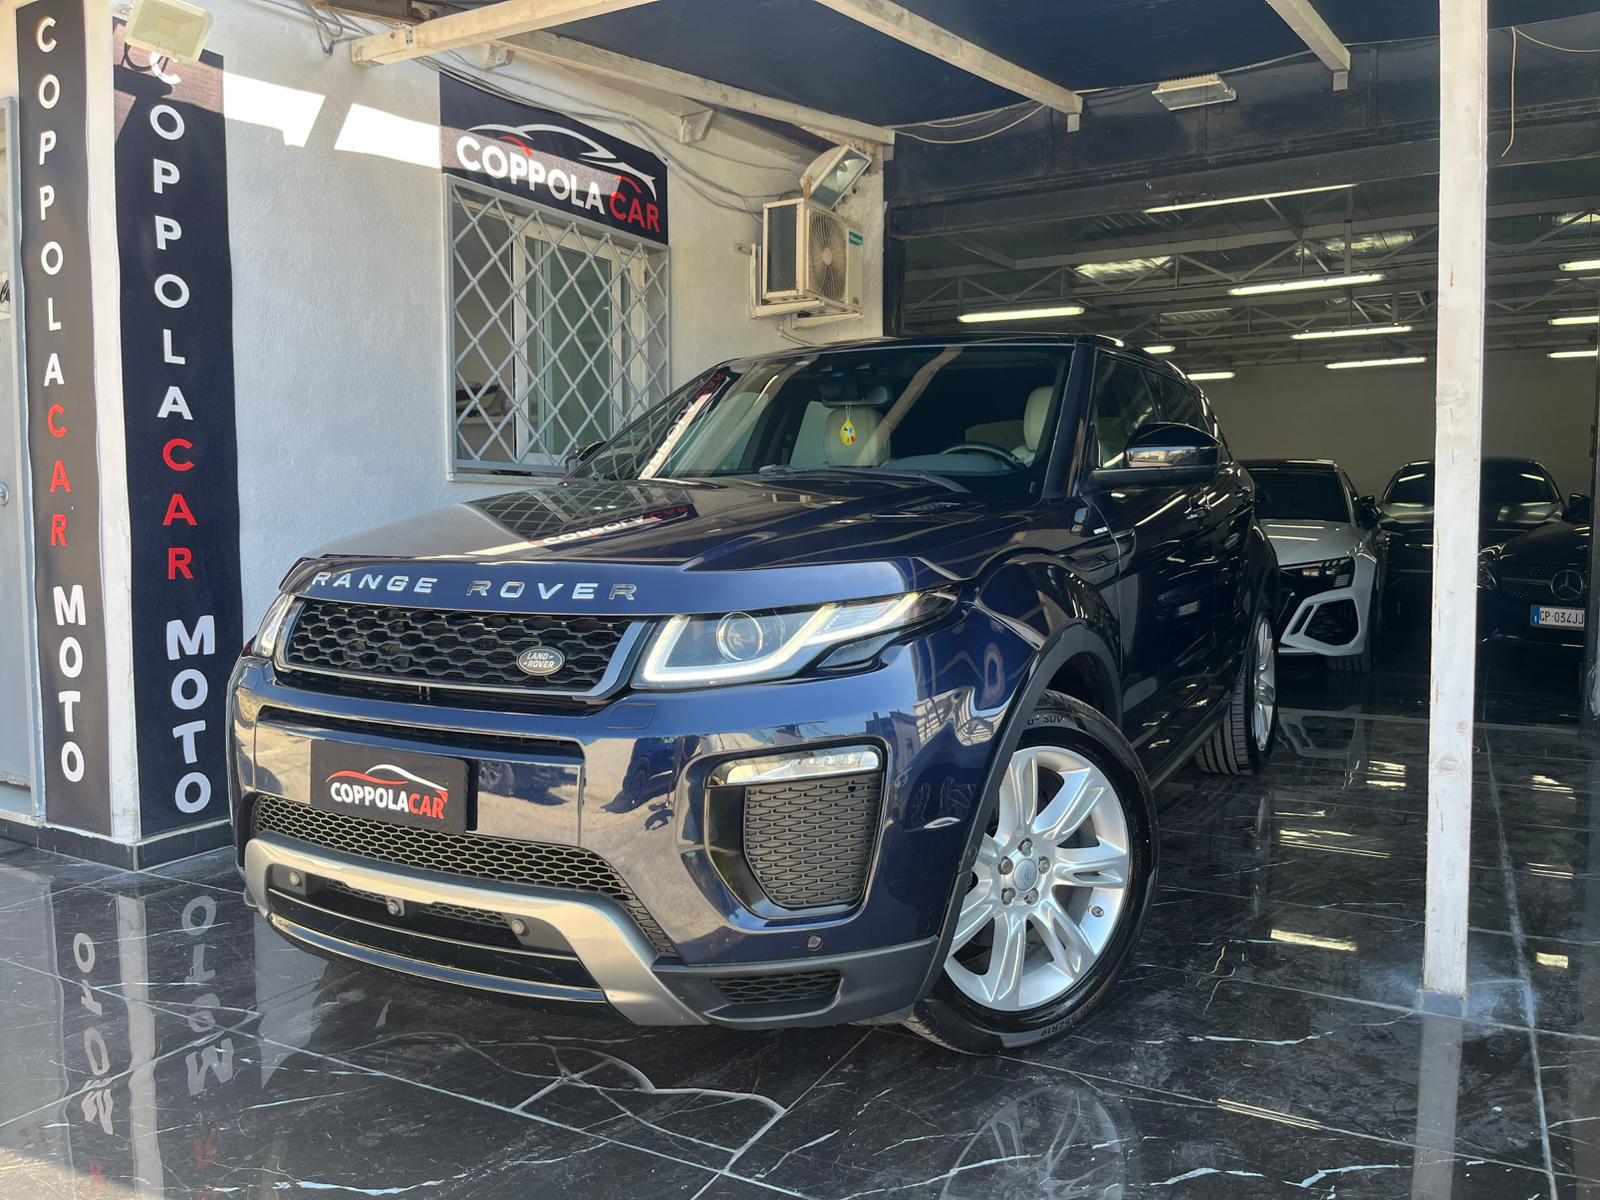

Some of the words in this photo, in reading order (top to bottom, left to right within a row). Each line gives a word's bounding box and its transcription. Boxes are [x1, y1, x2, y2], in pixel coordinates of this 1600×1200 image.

[311, 571, 438, 593] RANGE
[466, 580, 638, 600] ROVER
[526, 652, 549, 660] LAND
[526, 660, 555, 668] ROVER
[53, 585, 86, 782] MOTO
[166, 615, 215, 813] MOTO
[330, 781, 446, 820] COPPOLACAR
